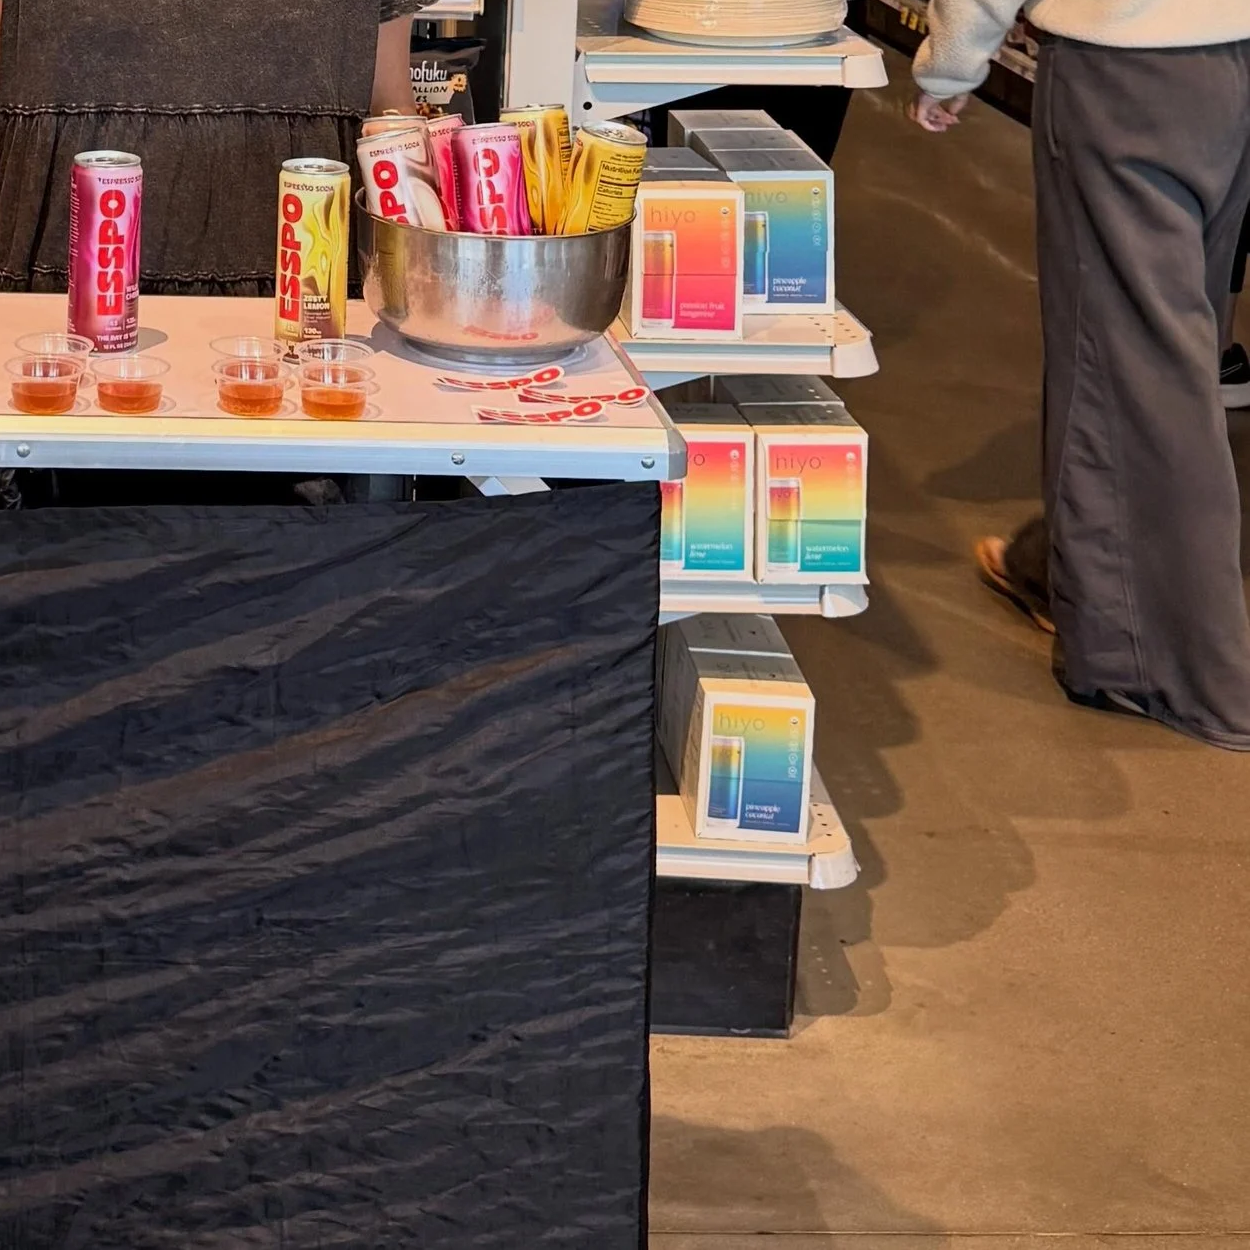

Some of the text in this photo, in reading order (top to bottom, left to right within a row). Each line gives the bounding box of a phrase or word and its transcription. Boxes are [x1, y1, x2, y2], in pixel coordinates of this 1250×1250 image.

[404, 141, 420, 150] SODA
[602, 163, 631, 174] Nutrition
[597, 186, 623, 196] Calories
[651, 206, 696, 227] hiyo
[97, 188, 126, 316] ESSPO
[279, 193, 303, 322] ESSPO
[773, 277, 807, 286] pineapple
[303, 302, 330, 310] LEMON
[775, 455, 822, 473] hiyo
[719, 712, 765, 734] hiyo
[745, 804, 781, 814] pineapple
